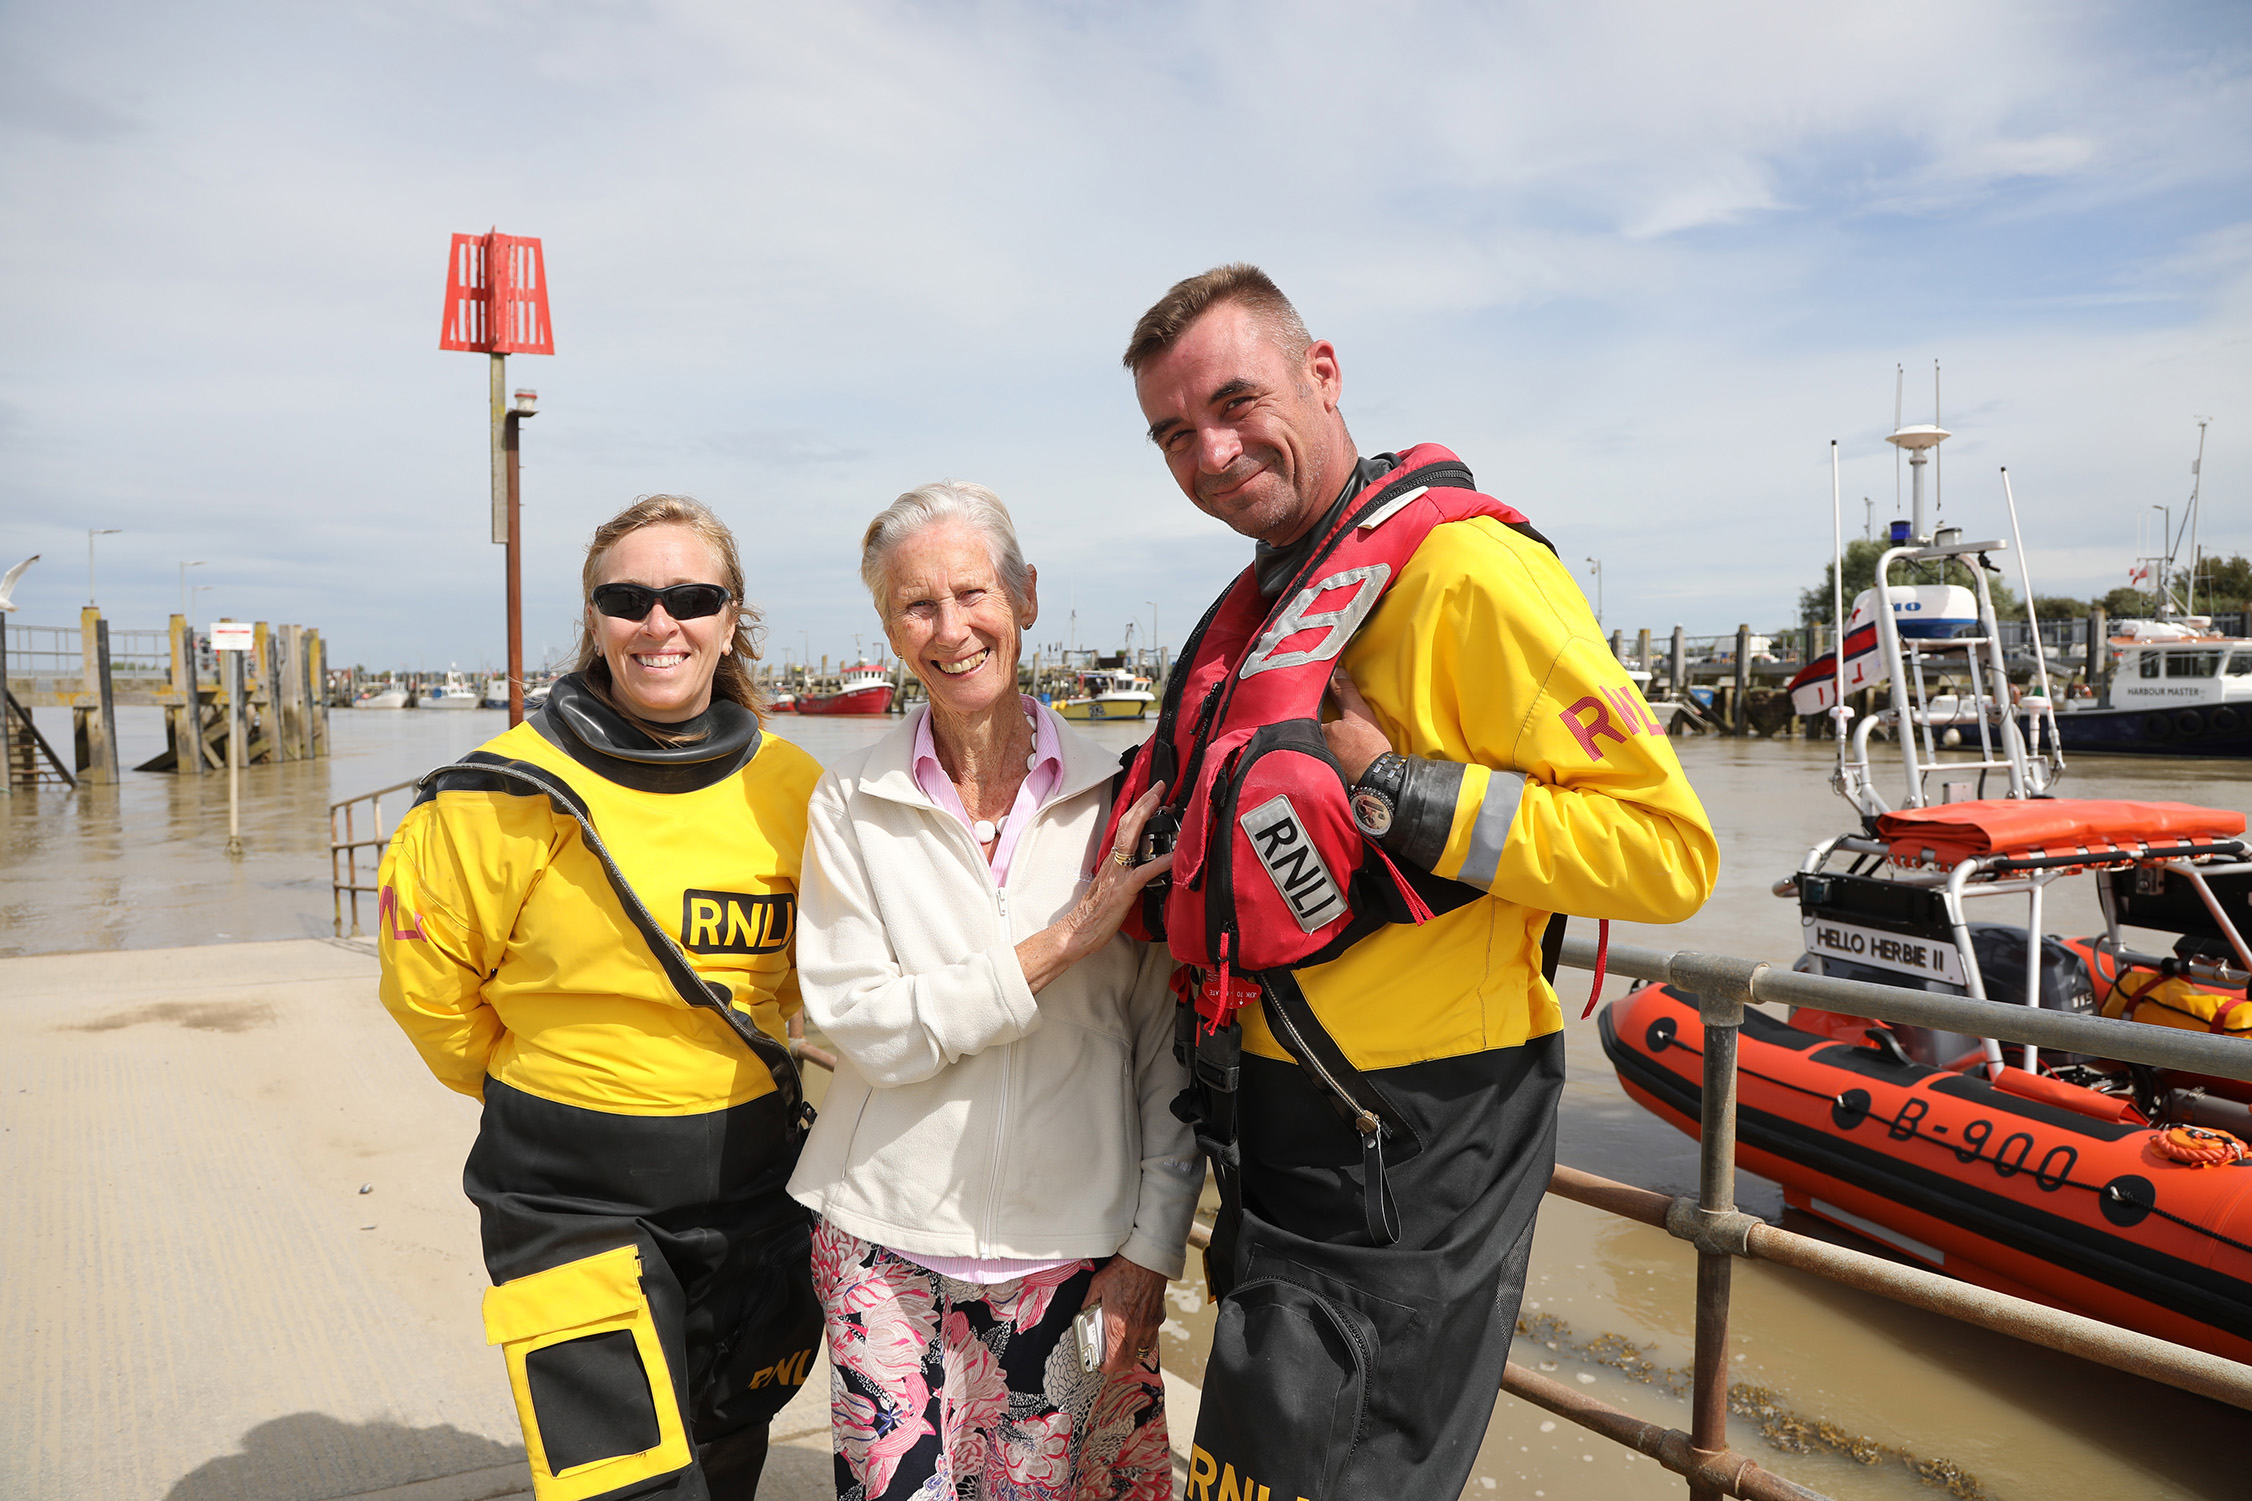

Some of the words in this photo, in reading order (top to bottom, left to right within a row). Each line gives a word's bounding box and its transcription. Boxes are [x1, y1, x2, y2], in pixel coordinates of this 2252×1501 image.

[2127, 686, 2166, 697] HARBOUR
[2167, 686, 2200, 697] MASTER
[1558, 685, 1667, 763] RNL
[1254, 816, 1338, 919] RNLI
[688, 897, 795, 948] RNLI
[1816, 926, 1866, 955] HELLO
[1870, 936, 1927, 969] HERBIE
[1888, 1097, 2078, 1192] B-900
